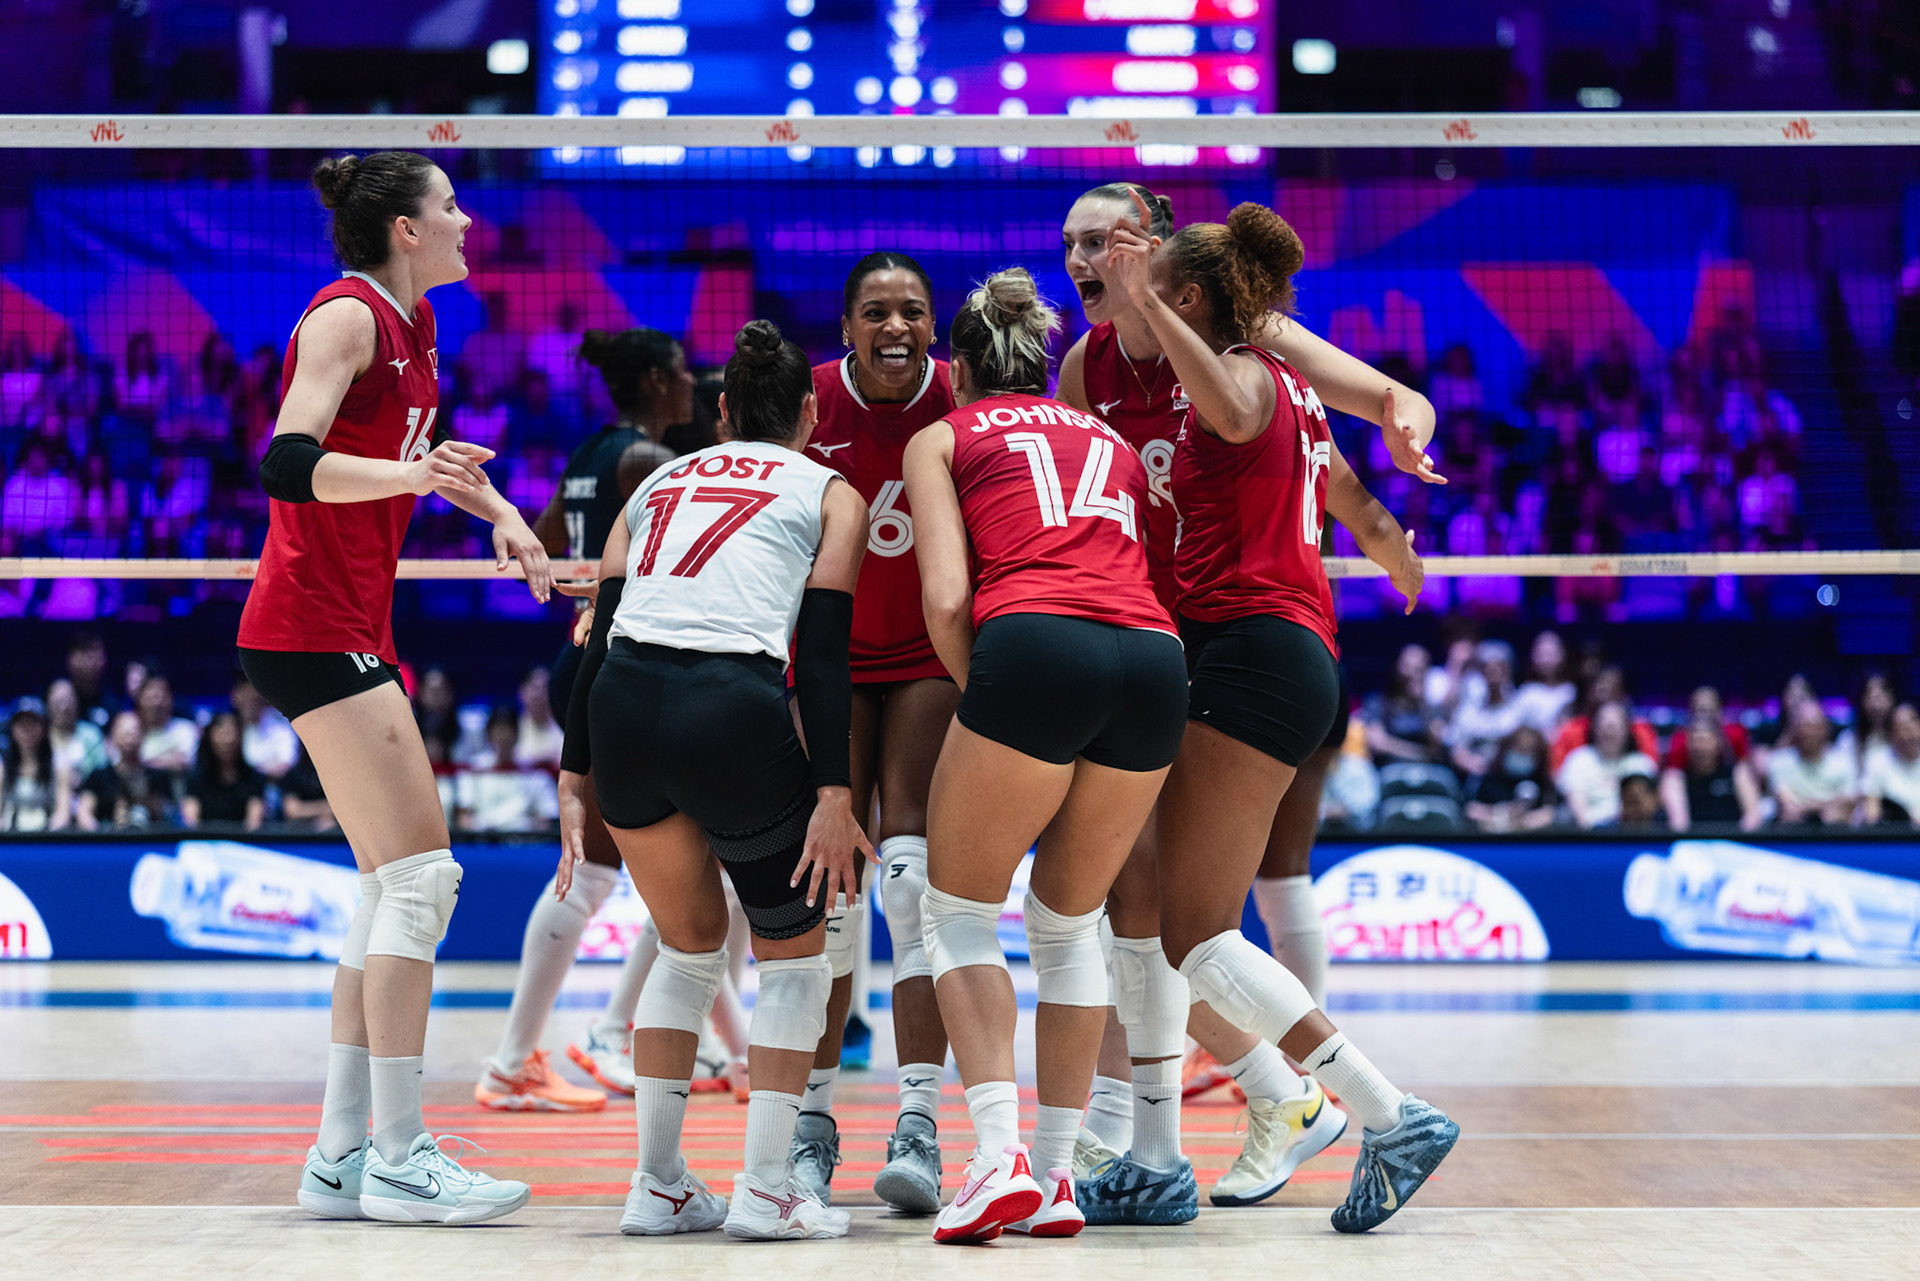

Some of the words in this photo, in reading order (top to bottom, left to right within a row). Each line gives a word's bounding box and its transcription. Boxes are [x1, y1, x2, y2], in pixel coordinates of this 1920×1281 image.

[90, 120, 124, 142] VNL
[970, 404, 1130, 452] JOHNSON
[669, 454, 785, 481] JOST
[1004, 432, 1138, 543] 14
[637, 486, 779, 578] 17
[867, 480, 914, 558] 6
